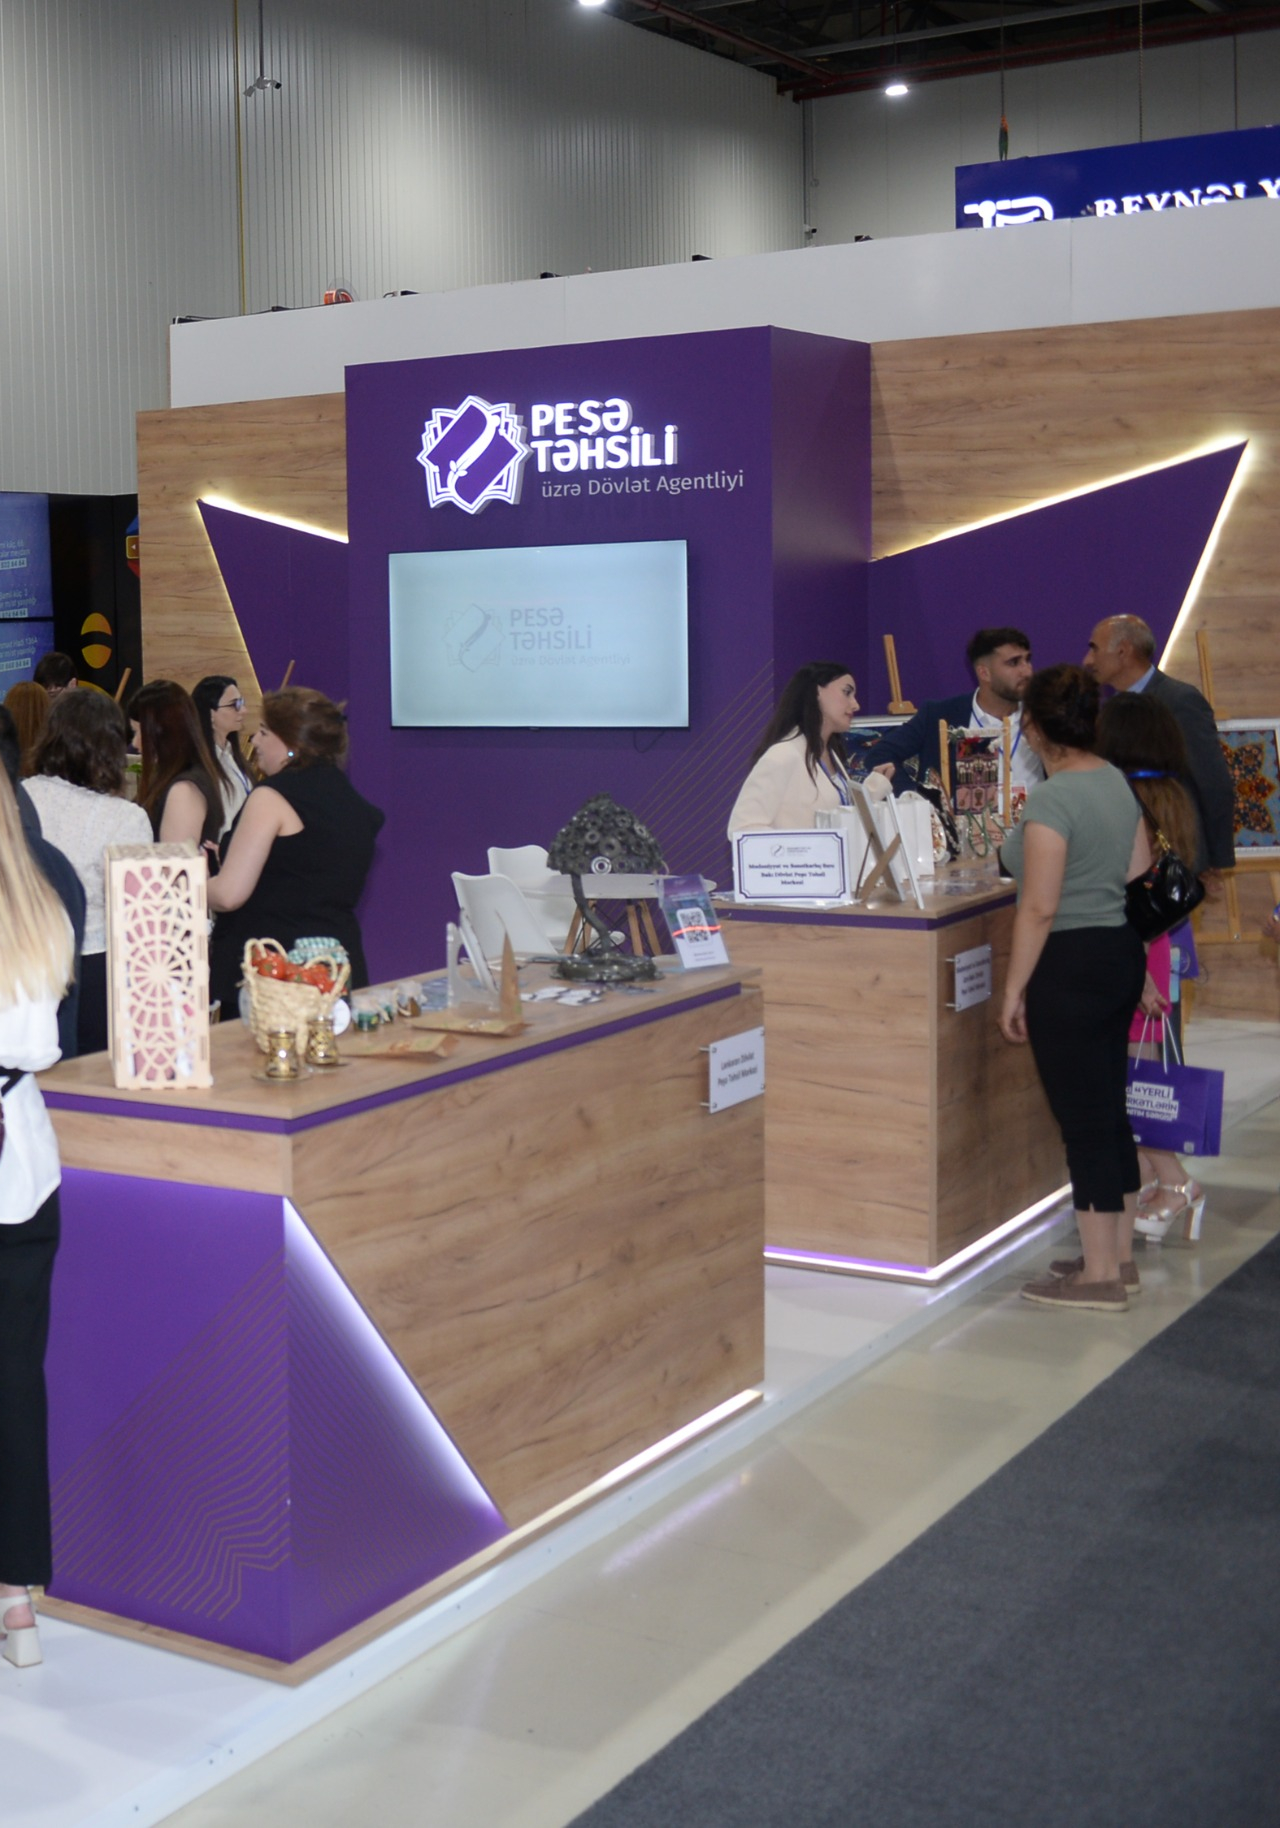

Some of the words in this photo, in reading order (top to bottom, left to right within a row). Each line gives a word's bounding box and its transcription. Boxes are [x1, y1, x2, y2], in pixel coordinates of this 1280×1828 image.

[530, 424, 677, 473] TƏHSİLİ
[542, 480, 582, 498] üzrə
[588, 476, 651, 496] Dövlət
[656, 468, 744, 495] Agentliyi
[510, 625, 592, 650] TƏHSİLİ
